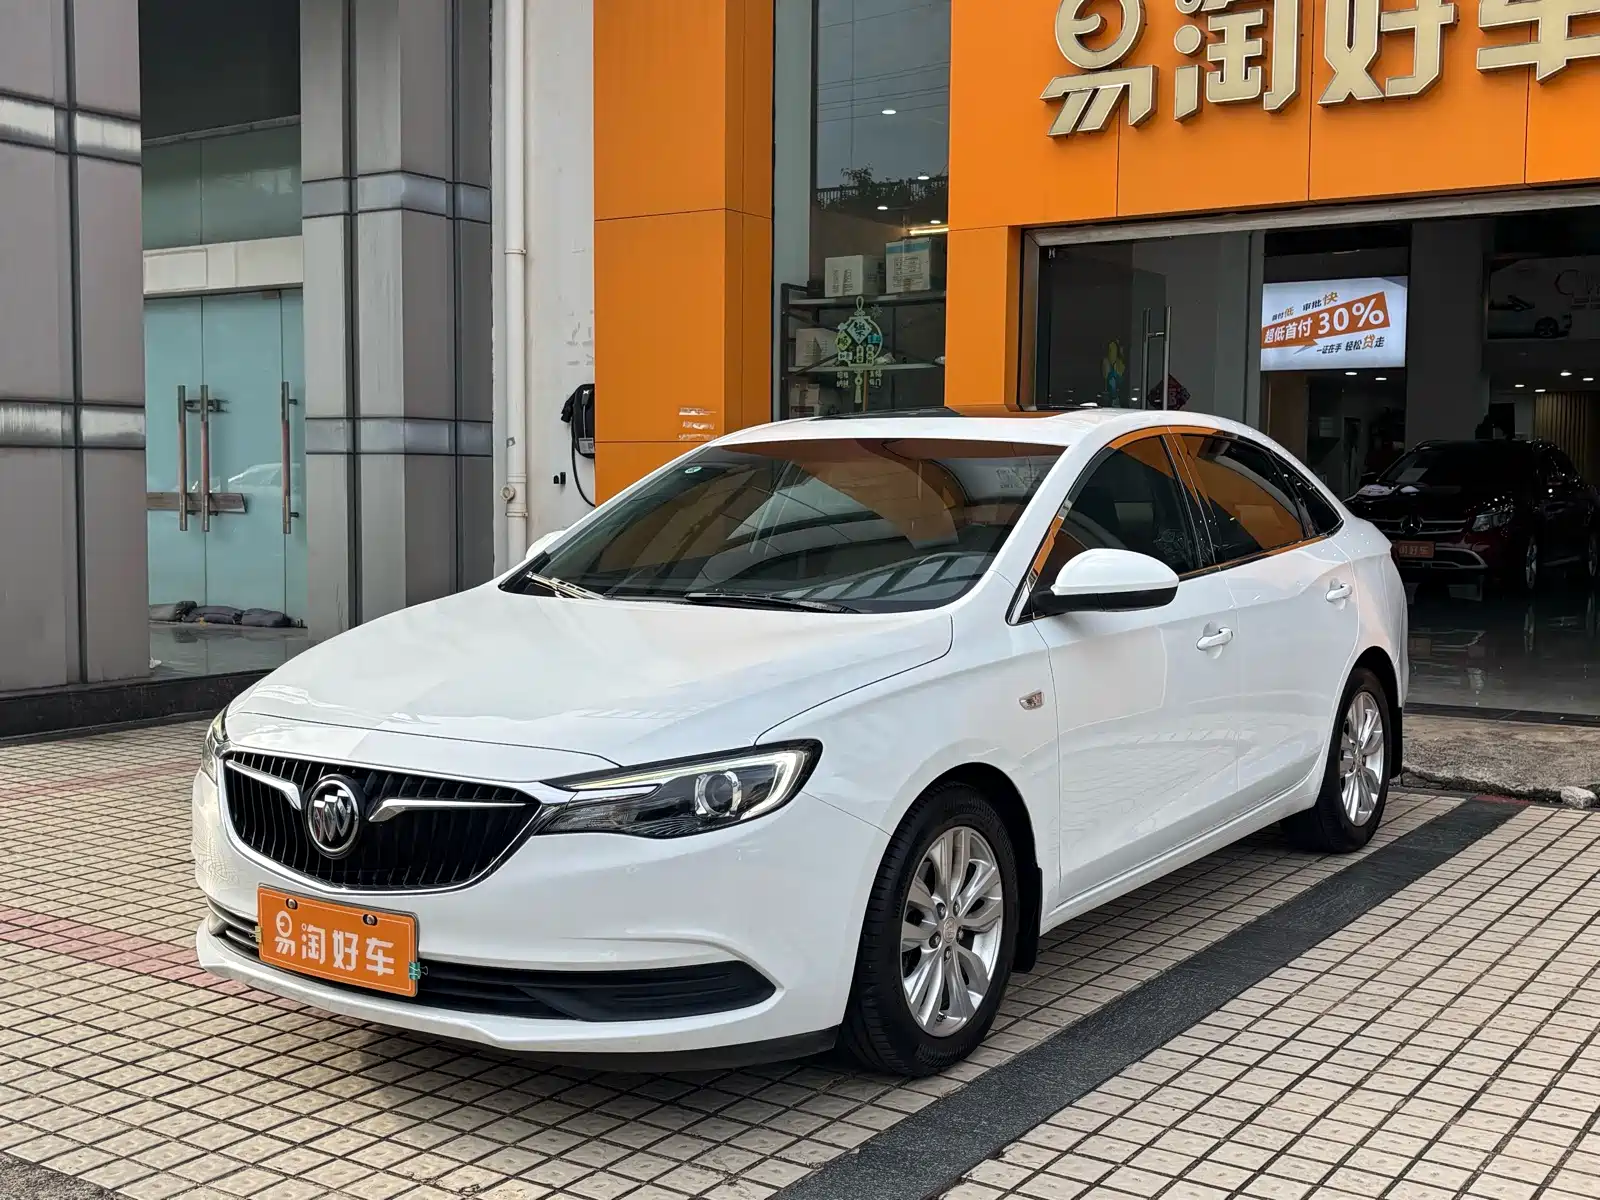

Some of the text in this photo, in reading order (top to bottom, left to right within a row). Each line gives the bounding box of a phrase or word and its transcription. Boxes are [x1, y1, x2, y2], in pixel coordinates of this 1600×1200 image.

[1264, 298, 1384, 344] 超低首付 30%
[1316, 334, 1384, 355] 一证在手 轻松贷走
[274, 910, 395, 977] 易淘好车
